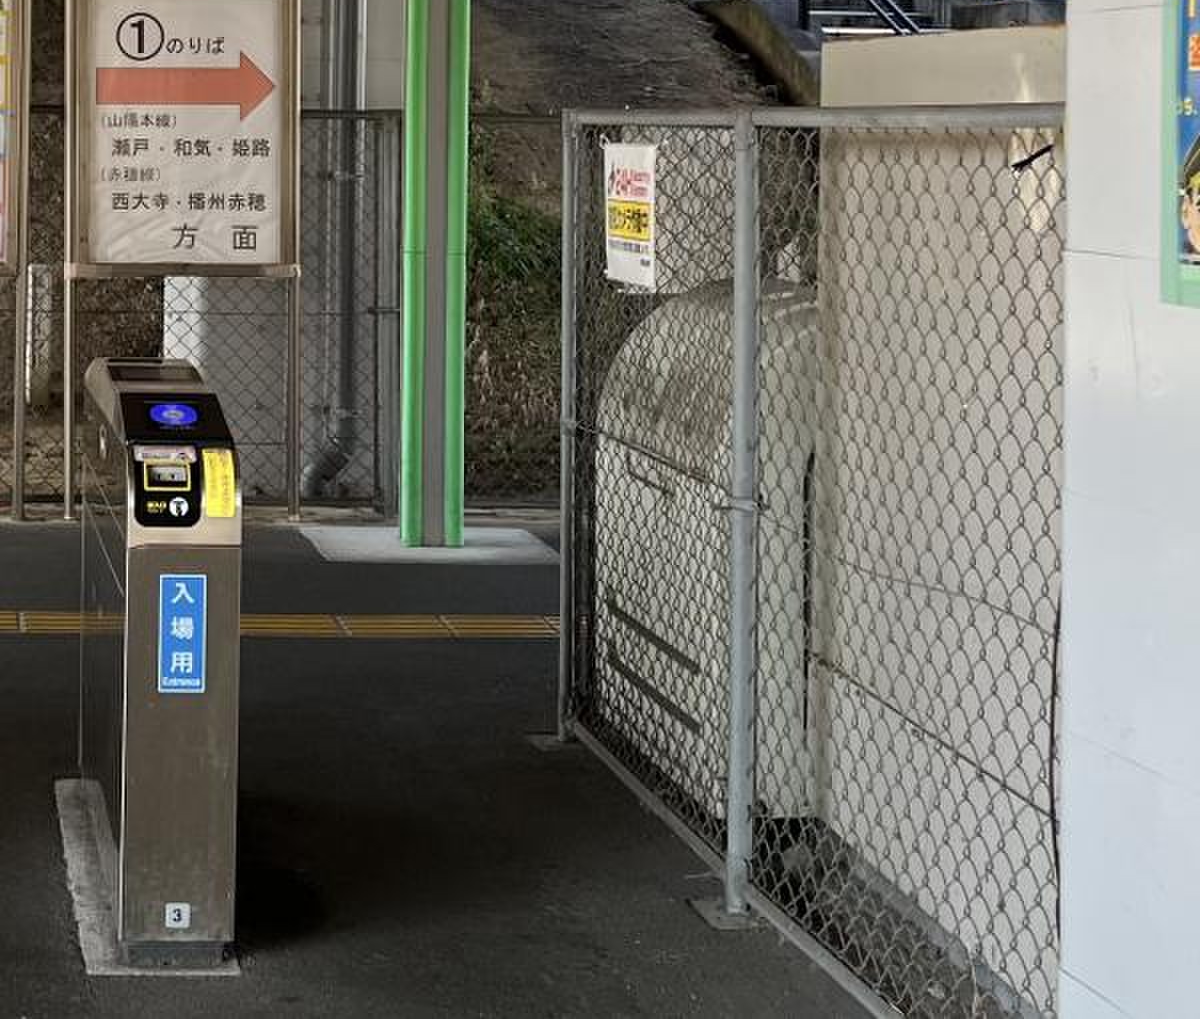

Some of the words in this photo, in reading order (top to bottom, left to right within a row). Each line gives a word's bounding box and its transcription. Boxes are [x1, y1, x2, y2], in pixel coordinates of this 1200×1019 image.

[166, 37, 225, 54] のりば
[170, 582, 195, 674] 入場用
[172, 907, 182, 923] 3
